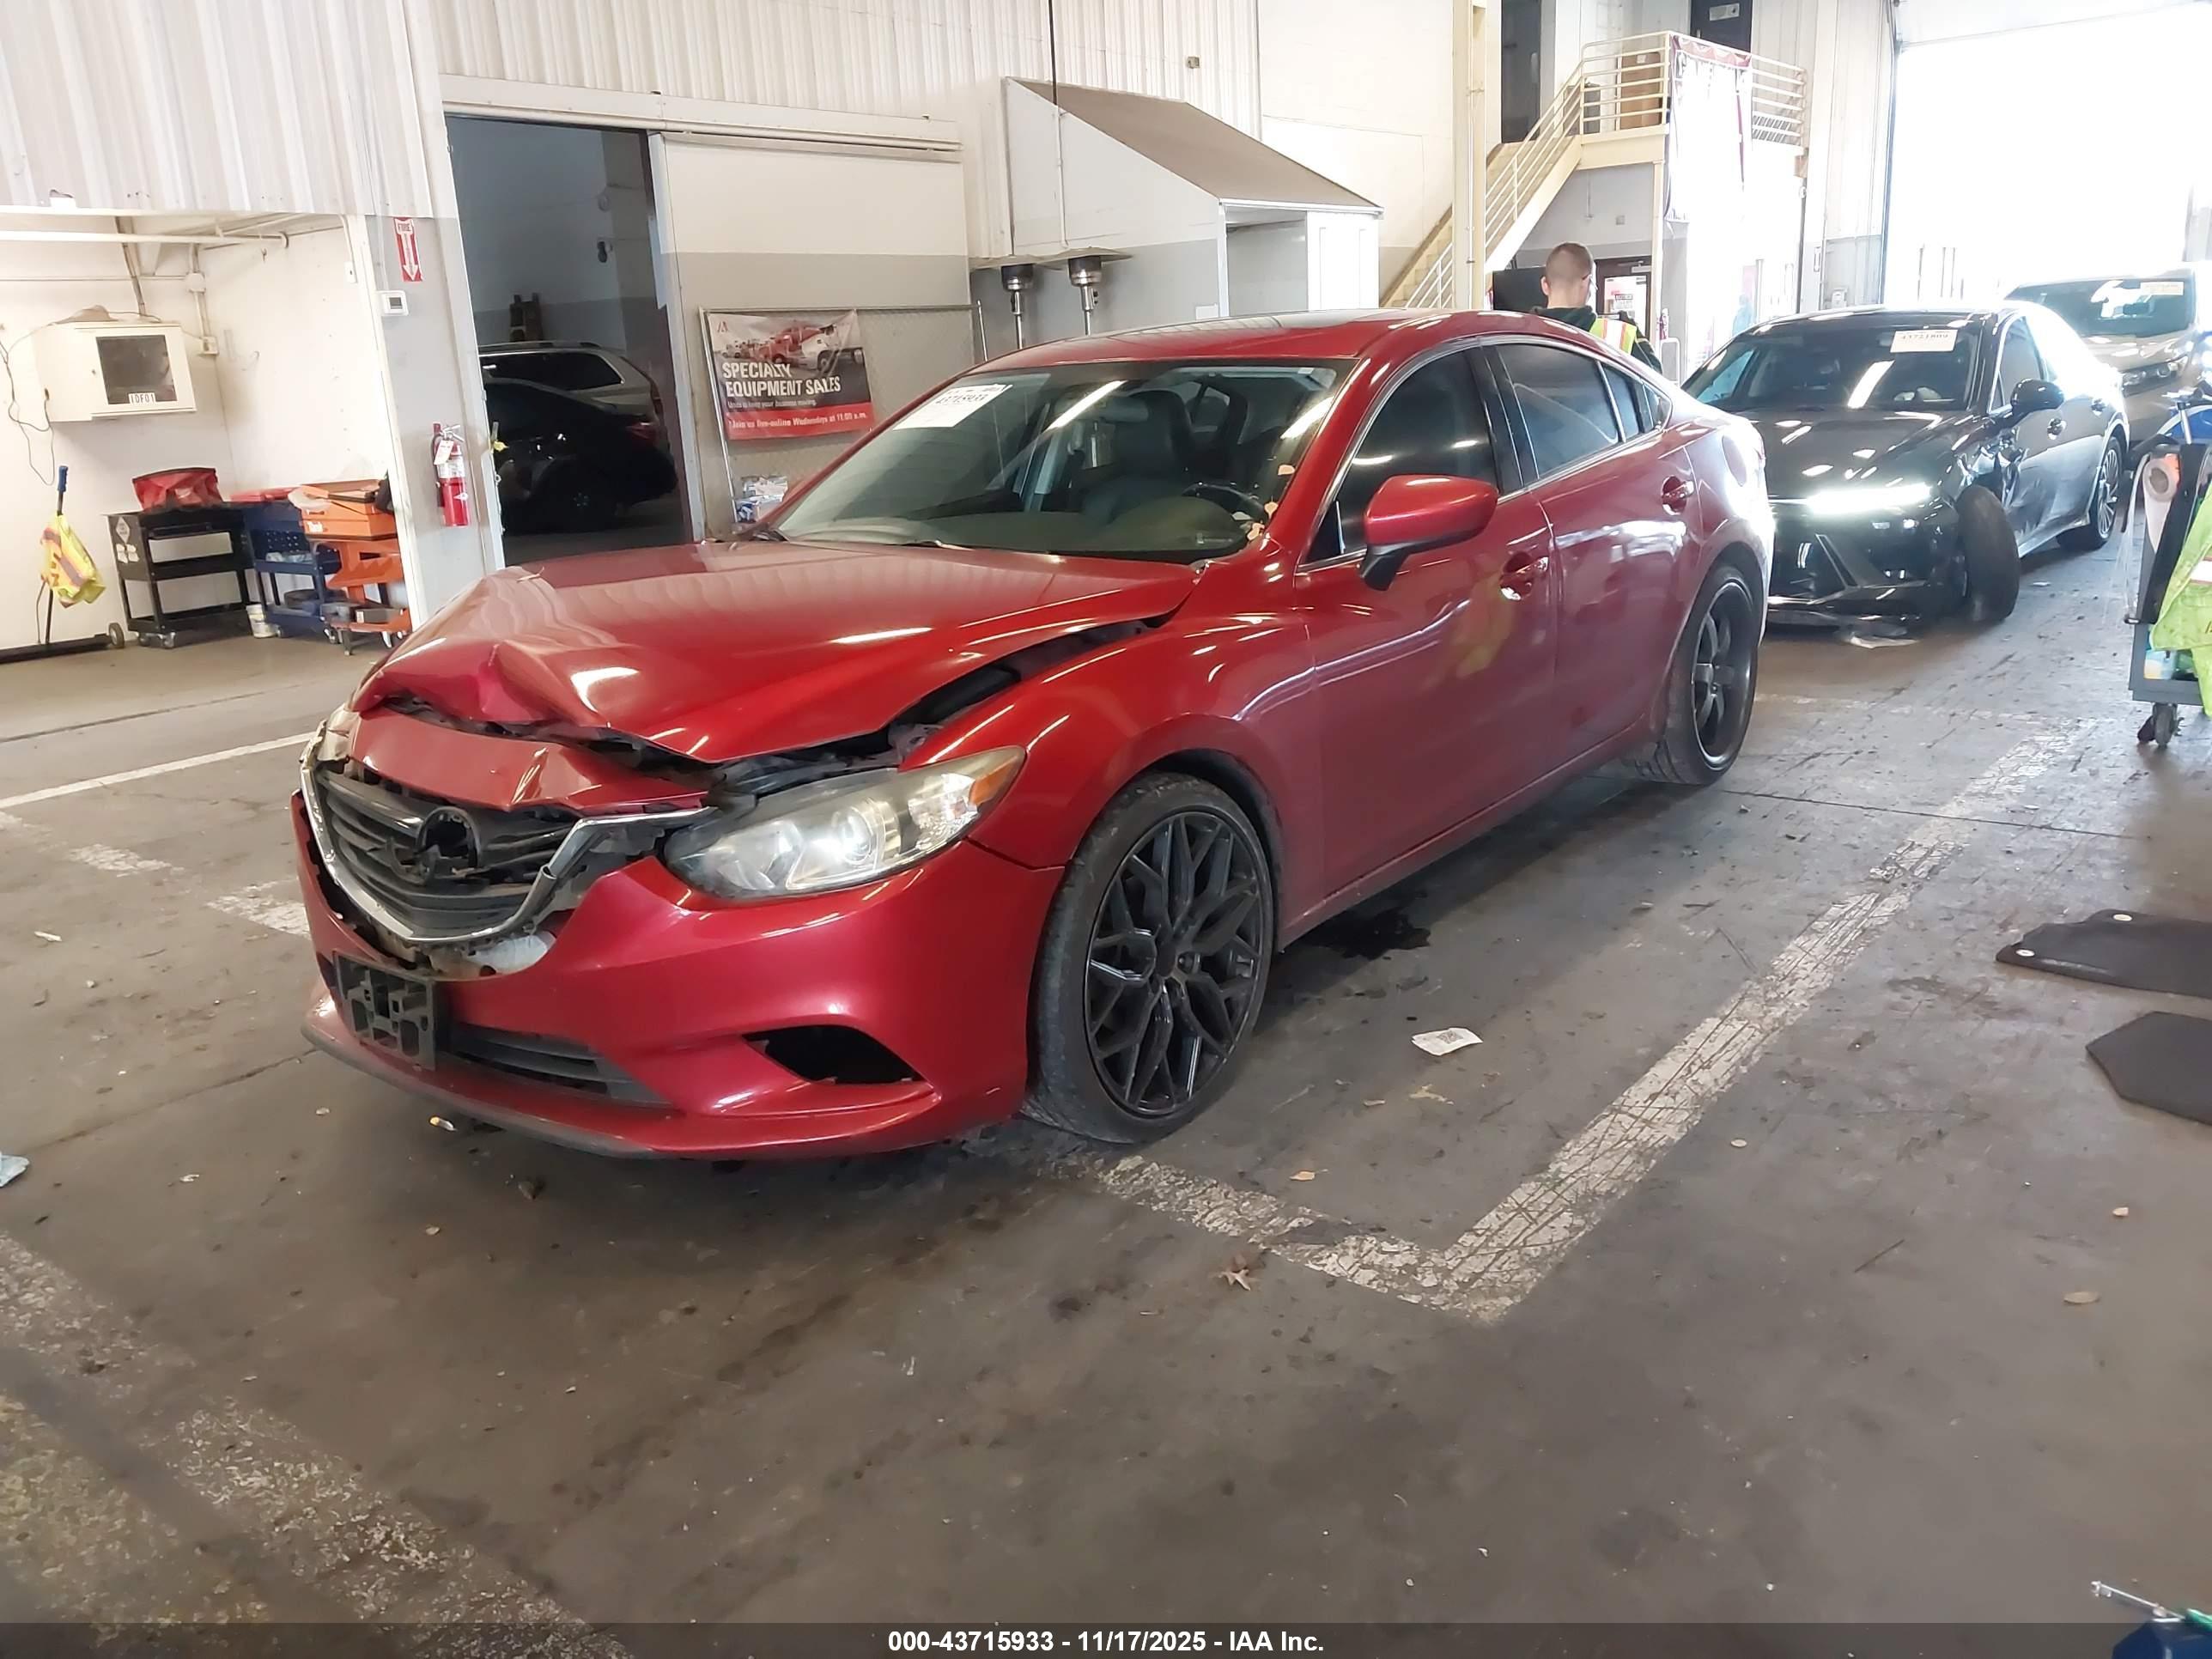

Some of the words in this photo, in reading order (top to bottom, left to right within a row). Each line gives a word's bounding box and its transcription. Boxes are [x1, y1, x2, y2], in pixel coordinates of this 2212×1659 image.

[722, 362, 792, 379] SPECIALTY
[726, 380, 802, 398] EQUIPMENT
[805, 376, 841, 395] SALES
